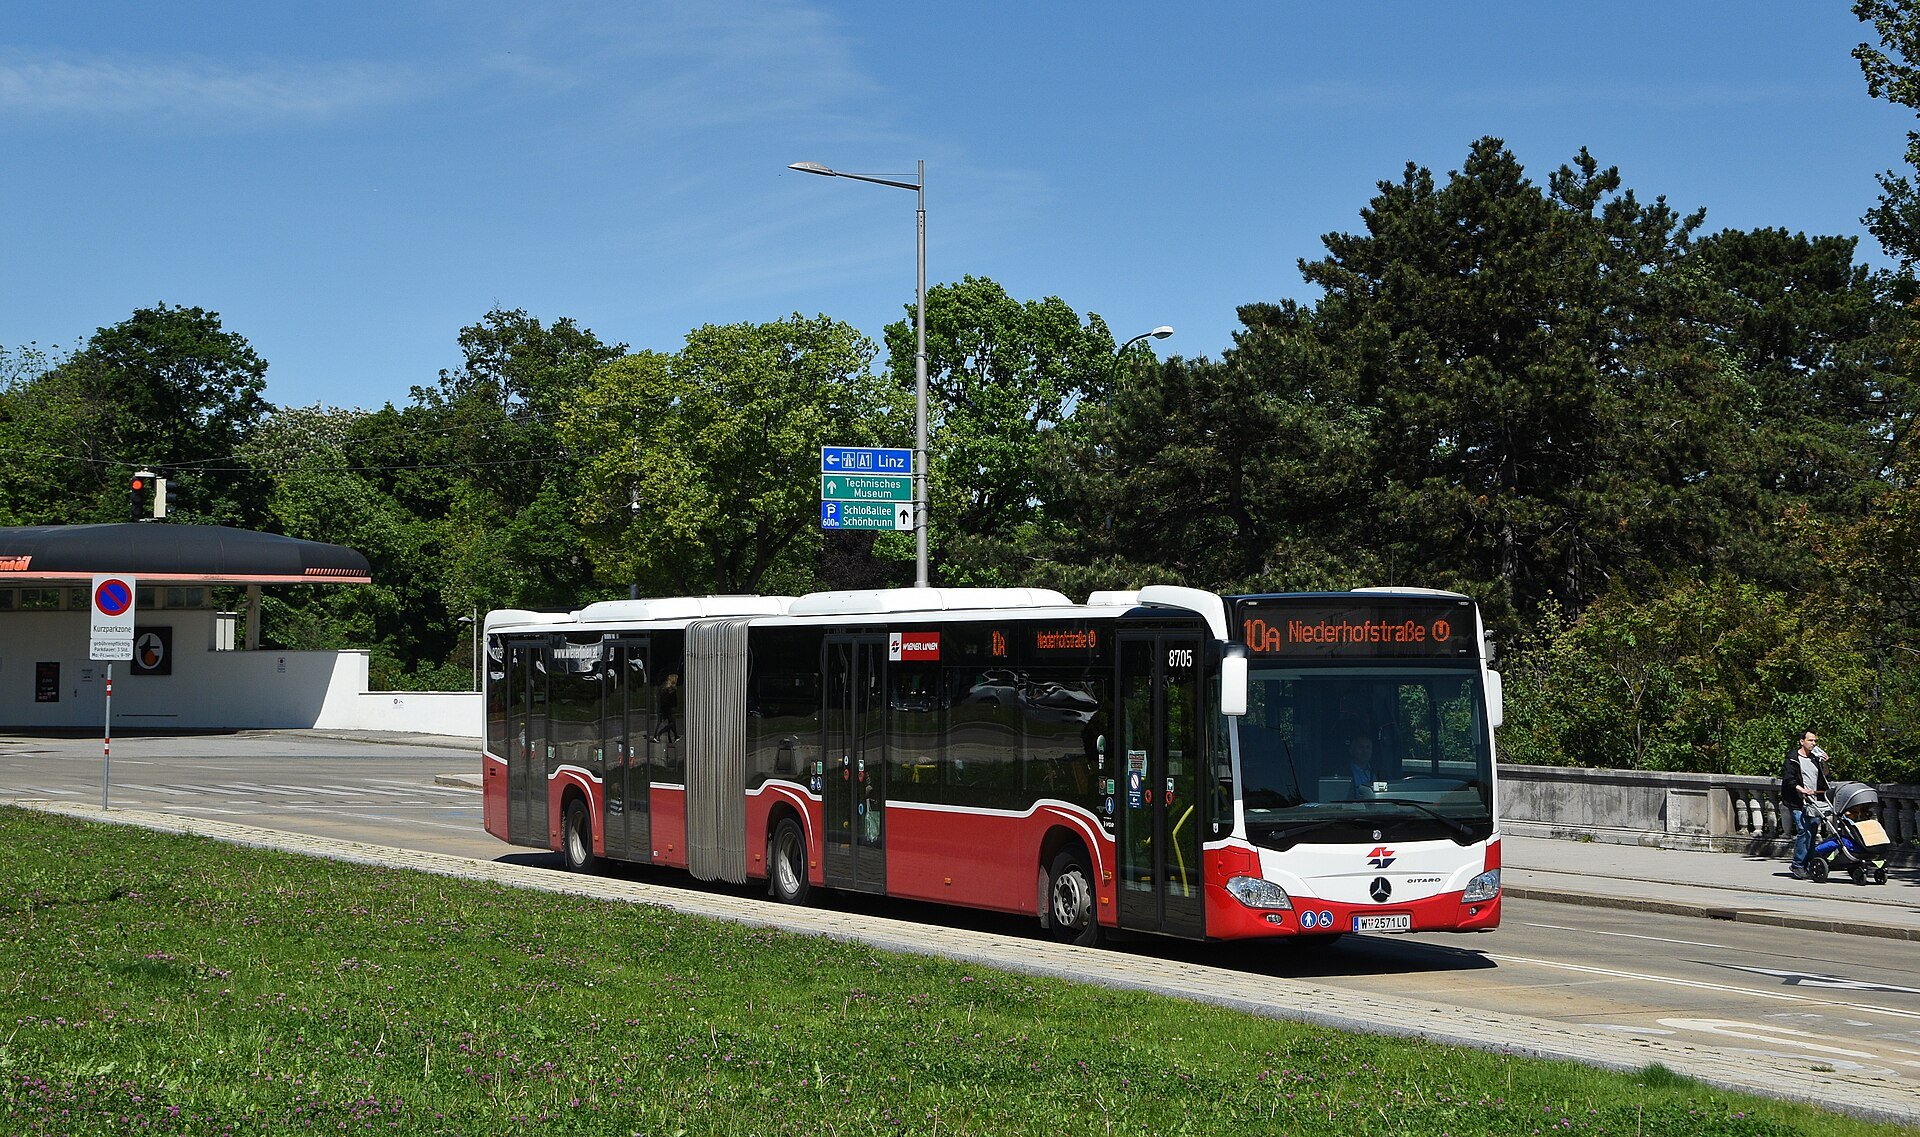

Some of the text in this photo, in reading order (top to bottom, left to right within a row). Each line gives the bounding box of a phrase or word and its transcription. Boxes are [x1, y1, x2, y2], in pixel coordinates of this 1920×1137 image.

[859, 453, 904, 468] A1 Linz
[845, 477, 901, 489] Technisches
[854, 488, 892, 499] Museum
[827, 506, 836, 518] P
[844, 505, 892, 516] Schloßallee
[822, 518, 840, 527] 600m
[843, 516, 893, 527] Schönbrunn
[93, 625, 132, 634] Kurzparkzone
[1243, 619, 1281, 652] 10A
[1288, 619, 1426, 643] Niederhofstraße
[902, 642, 922, 651] WIENER
[992, 630, 1006, 657] 10A
[1037, 630, 1087, 649] Niederhofstraße
[1168, 649, 1193, 668] 8705
